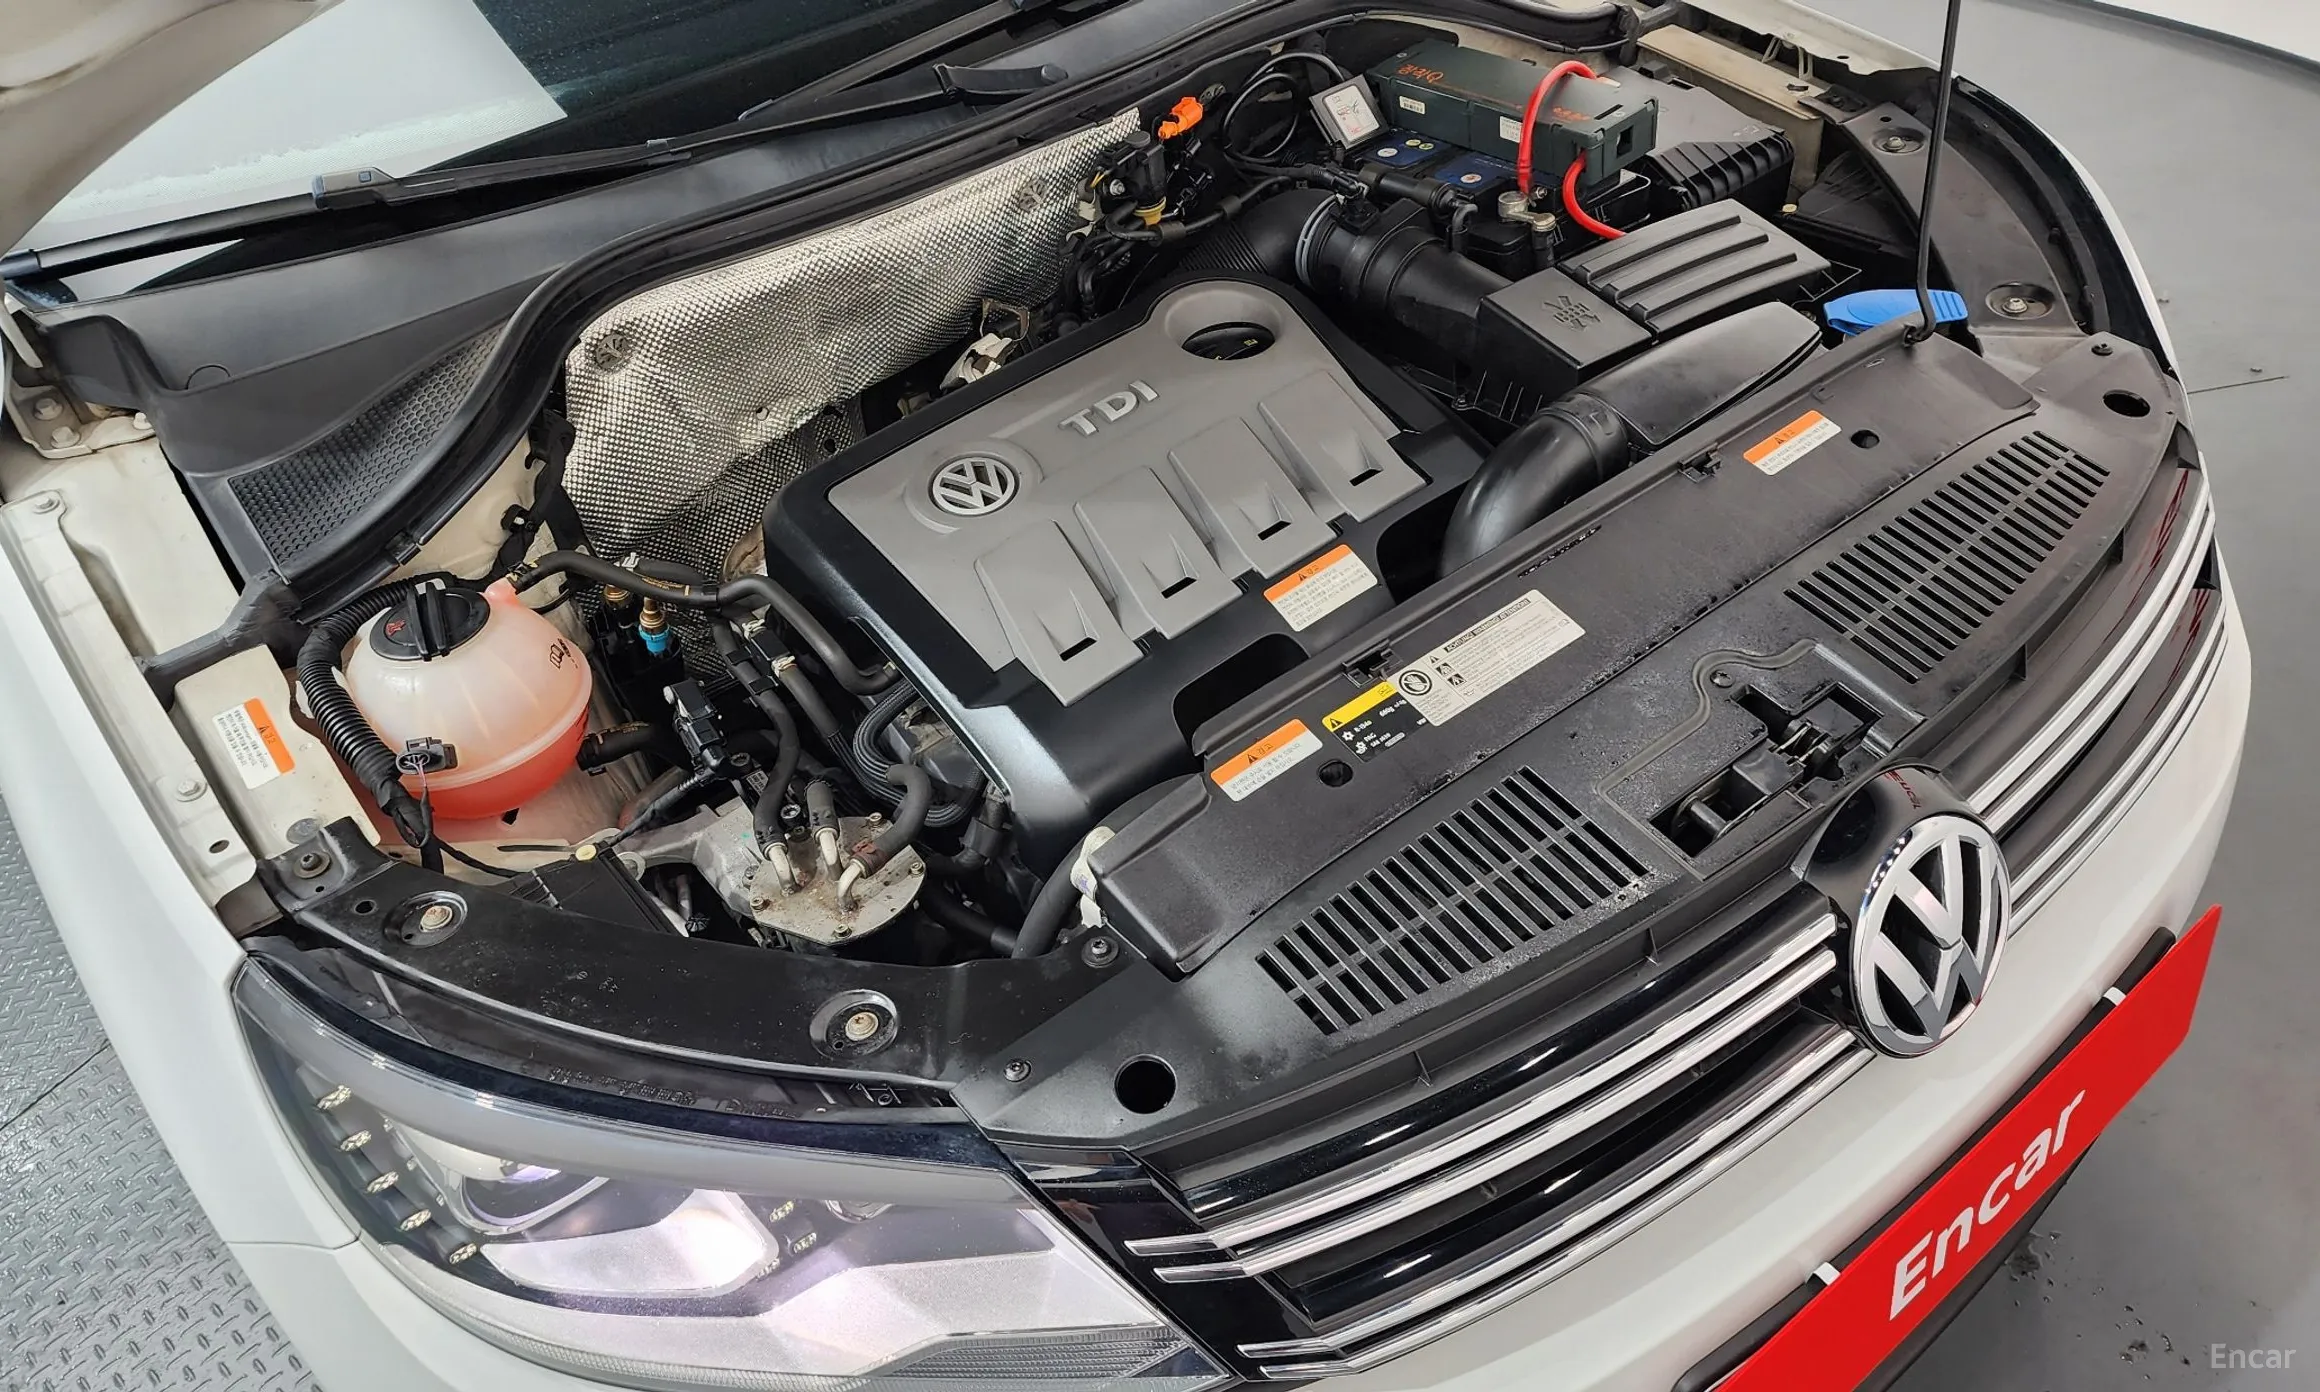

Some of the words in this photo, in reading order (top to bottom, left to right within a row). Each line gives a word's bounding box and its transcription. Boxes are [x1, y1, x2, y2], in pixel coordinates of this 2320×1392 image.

[1059, 380, 1159, 436] TDI
[1853, 814, 2011, 1055] VW
[1889, 1089, 2087, 1322] Encar
